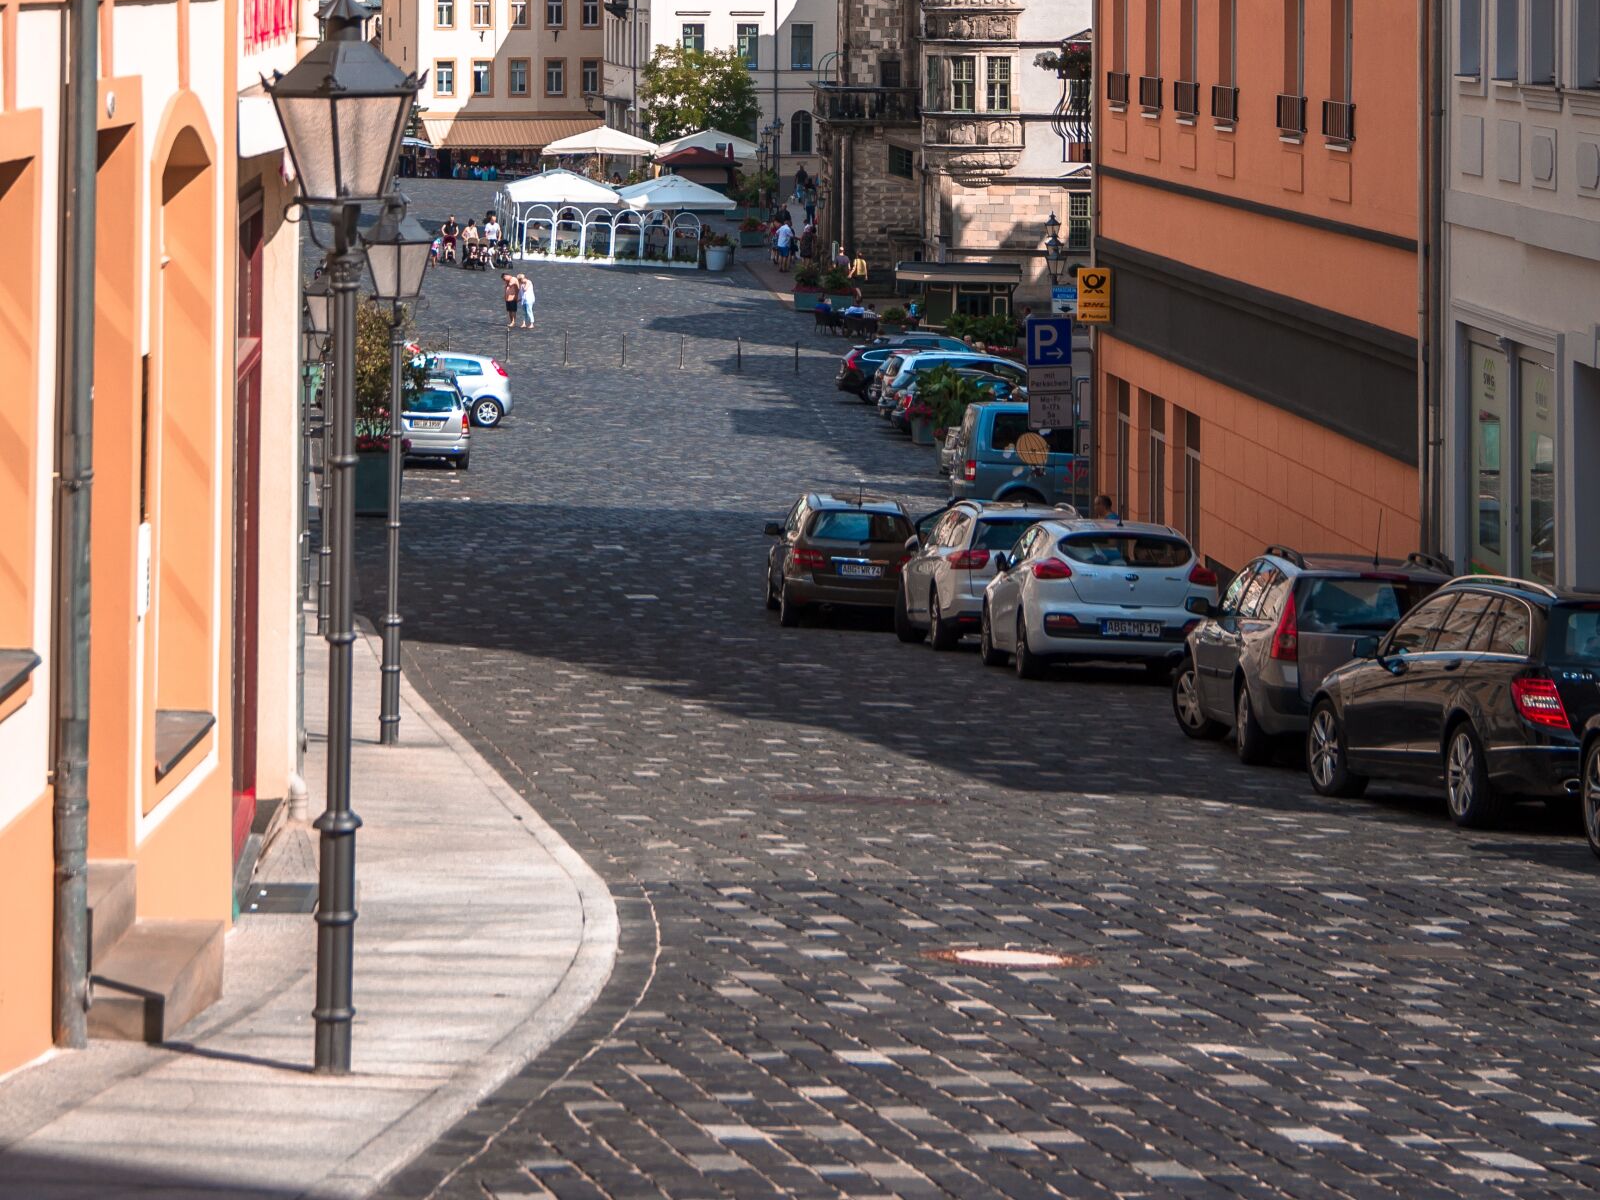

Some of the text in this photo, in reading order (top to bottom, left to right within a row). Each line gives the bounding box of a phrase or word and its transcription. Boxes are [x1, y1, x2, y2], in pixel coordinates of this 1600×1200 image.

[1034, 325, 1058, 360] P
[1043, 371, 1055, 379] mit
[1108, 621, 1127, 632] ABG
